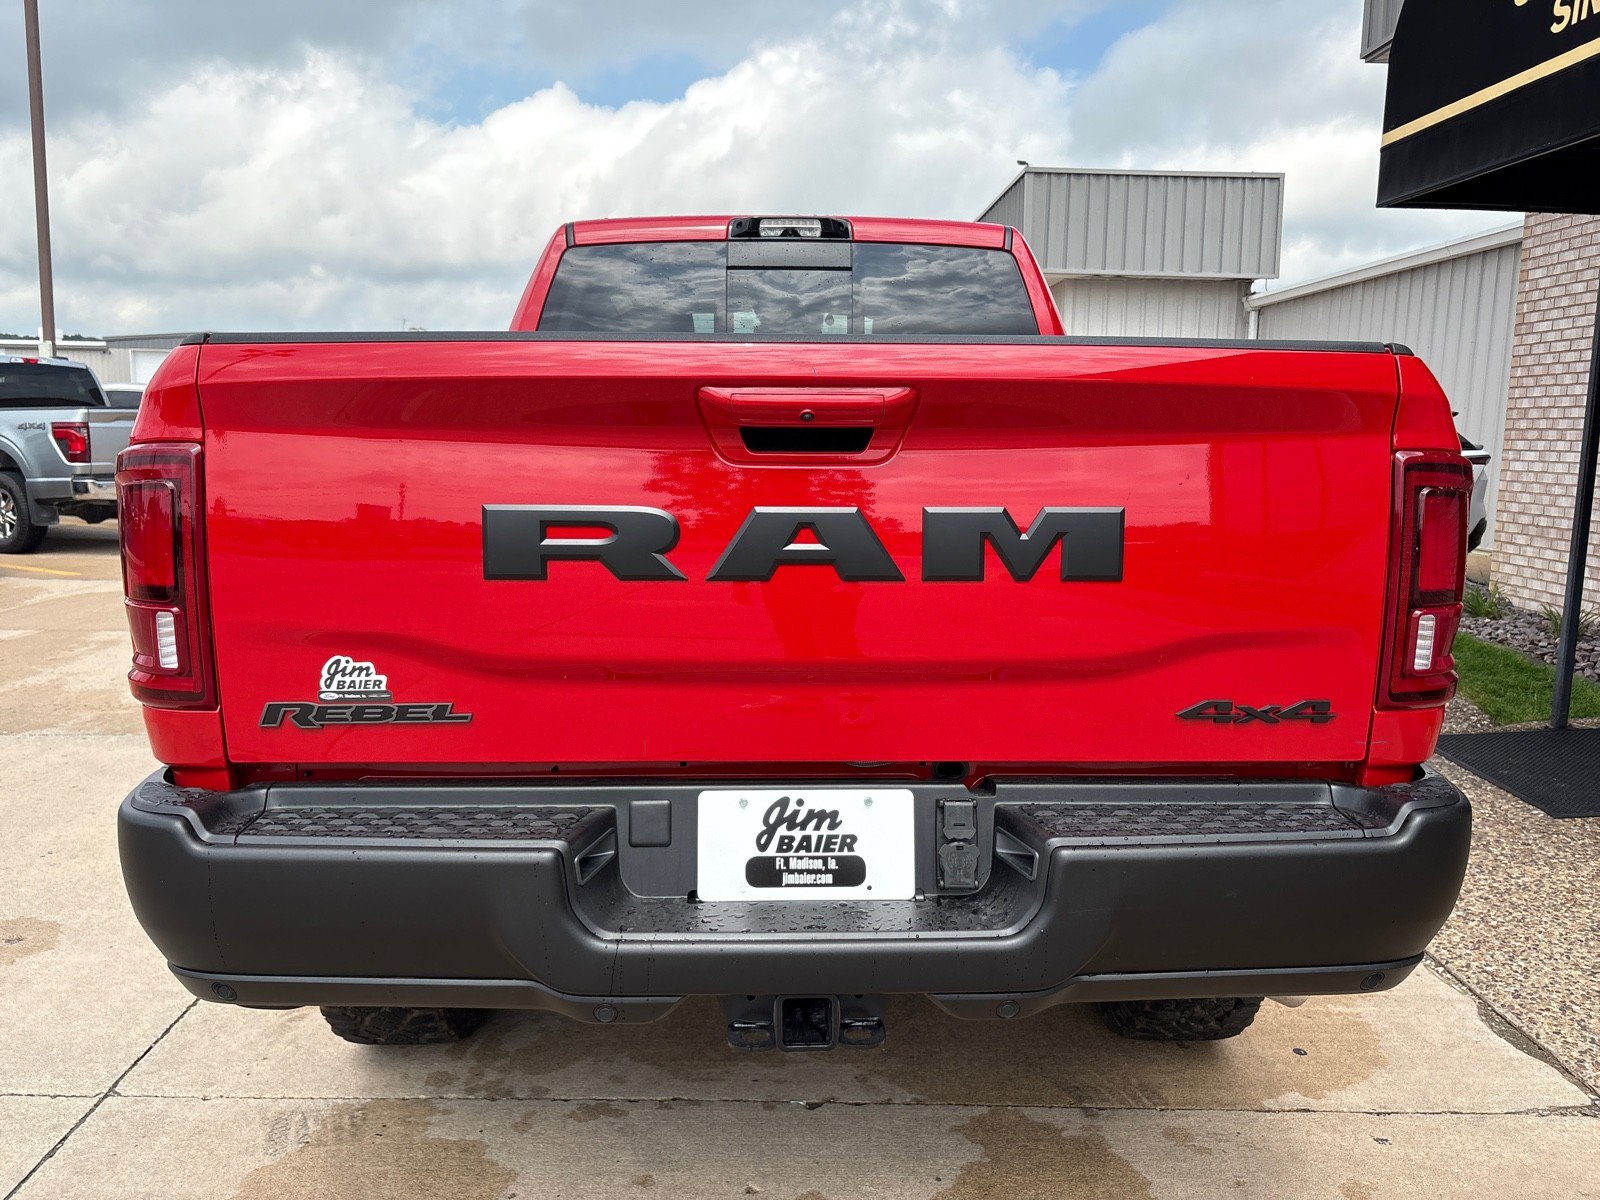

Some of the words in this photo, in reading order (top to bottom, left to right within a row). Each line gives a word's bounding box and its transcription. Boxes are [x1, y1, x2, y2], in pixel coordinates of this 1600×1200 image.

[482, 504, 1125, 582] RAM
[324, 658, 374, 689] Jim
[336, 679, 383, 690] BAIER
[259, 702, 473, 728] REBEL
[1174, 699, 1338, 724] 4x4
[756, 796, 843, 853] Jim
[775, 834, 858, 853] BAIER
[776, 857, 787, 870] Ft.
[789, 857, 826, 871] Madison,
[782, 872, 833, 886] jimbaier.com
